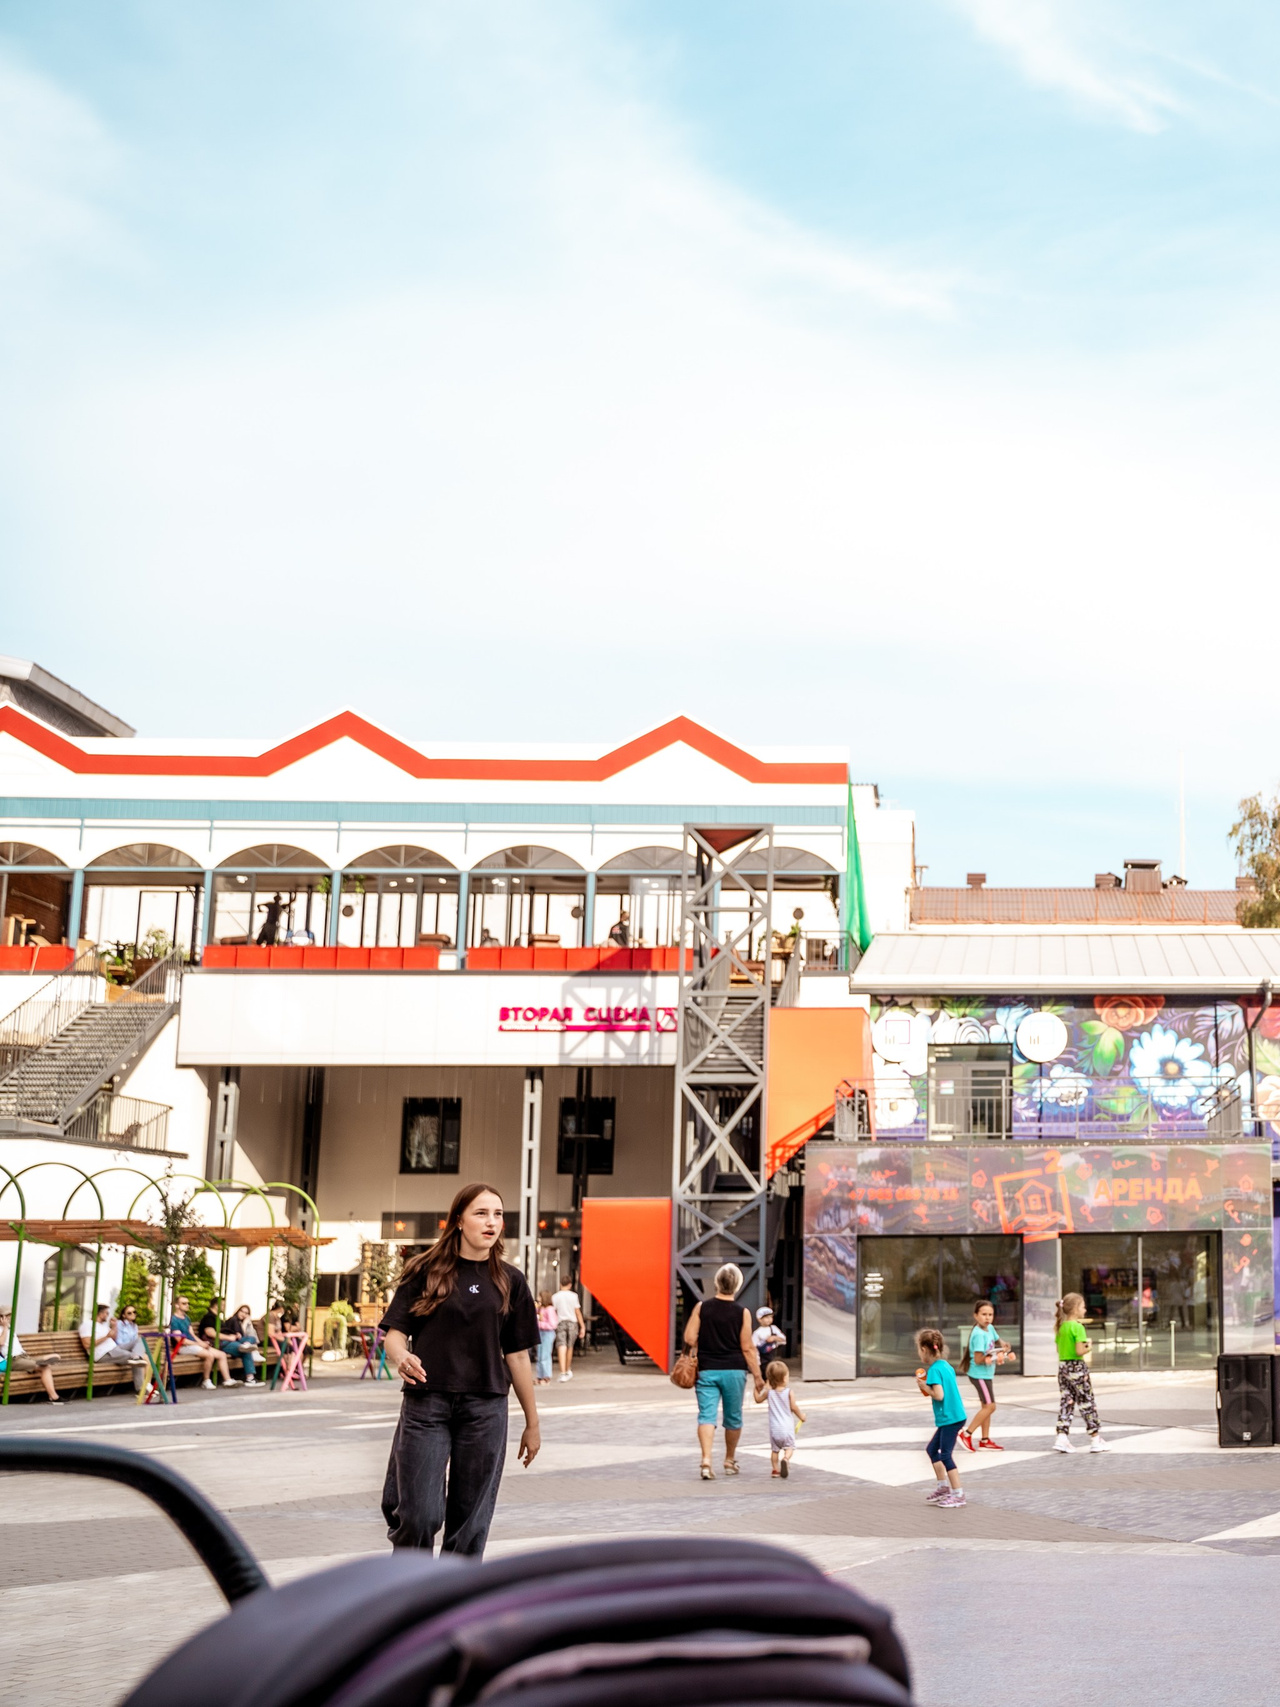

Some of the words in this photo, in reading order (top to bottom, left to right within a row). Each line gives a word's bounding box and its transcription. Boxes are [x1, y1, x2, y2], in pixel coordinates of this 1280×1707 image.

[499, 1007, 573, 1022] ВТОРАЯ
[584, 1006, 650, 1025] СЦЕНА
[1094, 1177, 1203, 1204] АРЕНДА
